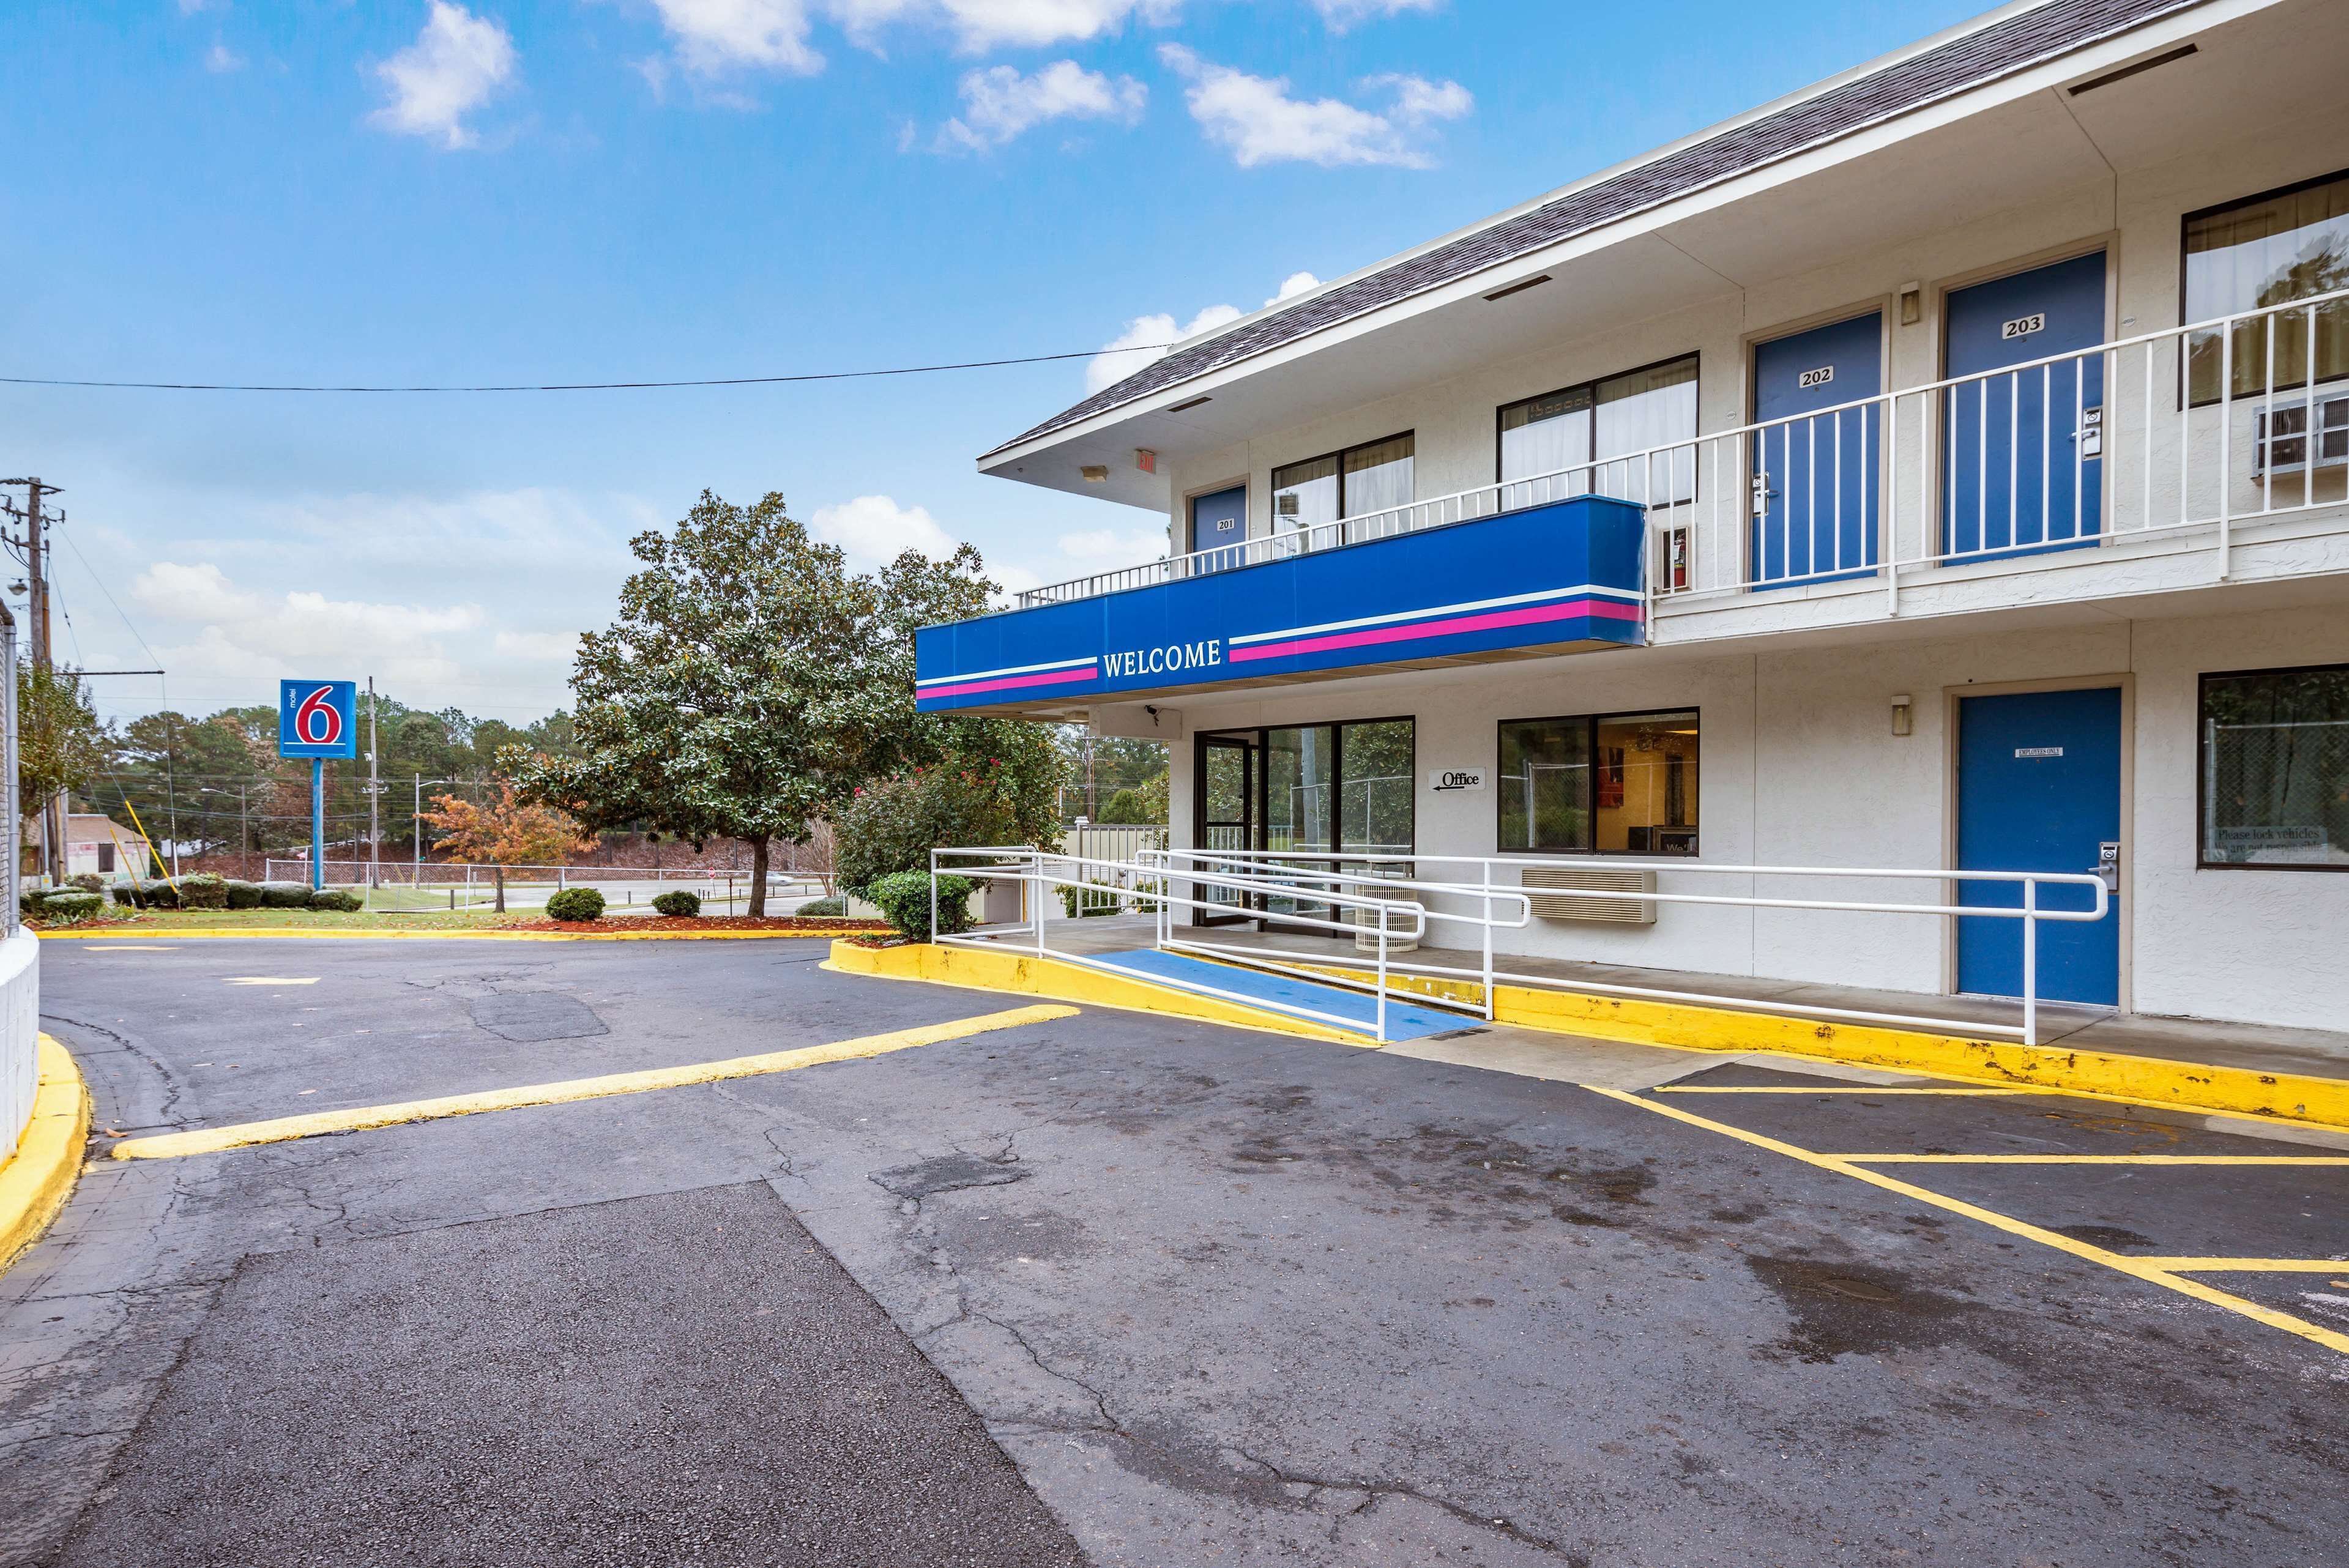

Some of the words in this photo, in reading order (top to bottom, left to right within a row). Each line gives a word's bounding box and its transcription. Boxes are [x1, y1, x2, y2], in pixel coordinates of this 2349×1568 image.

[2006, 316, 2041, 336] 203
[1803, 369, 1830, 385] 202
[1140, 453, 1153, 471] EXIT
[1219, 519, 1232, 530] 201
[1103, 639, 1221, 678] WELCOME
[295, 685, 342, 745] 6
[1442, 771, 1479, 787] Office
[2217, 830, 2250, 840] Please
[2254, 828, 2274, 839] lock
[2277, 828, 2320, 839] vehicles
